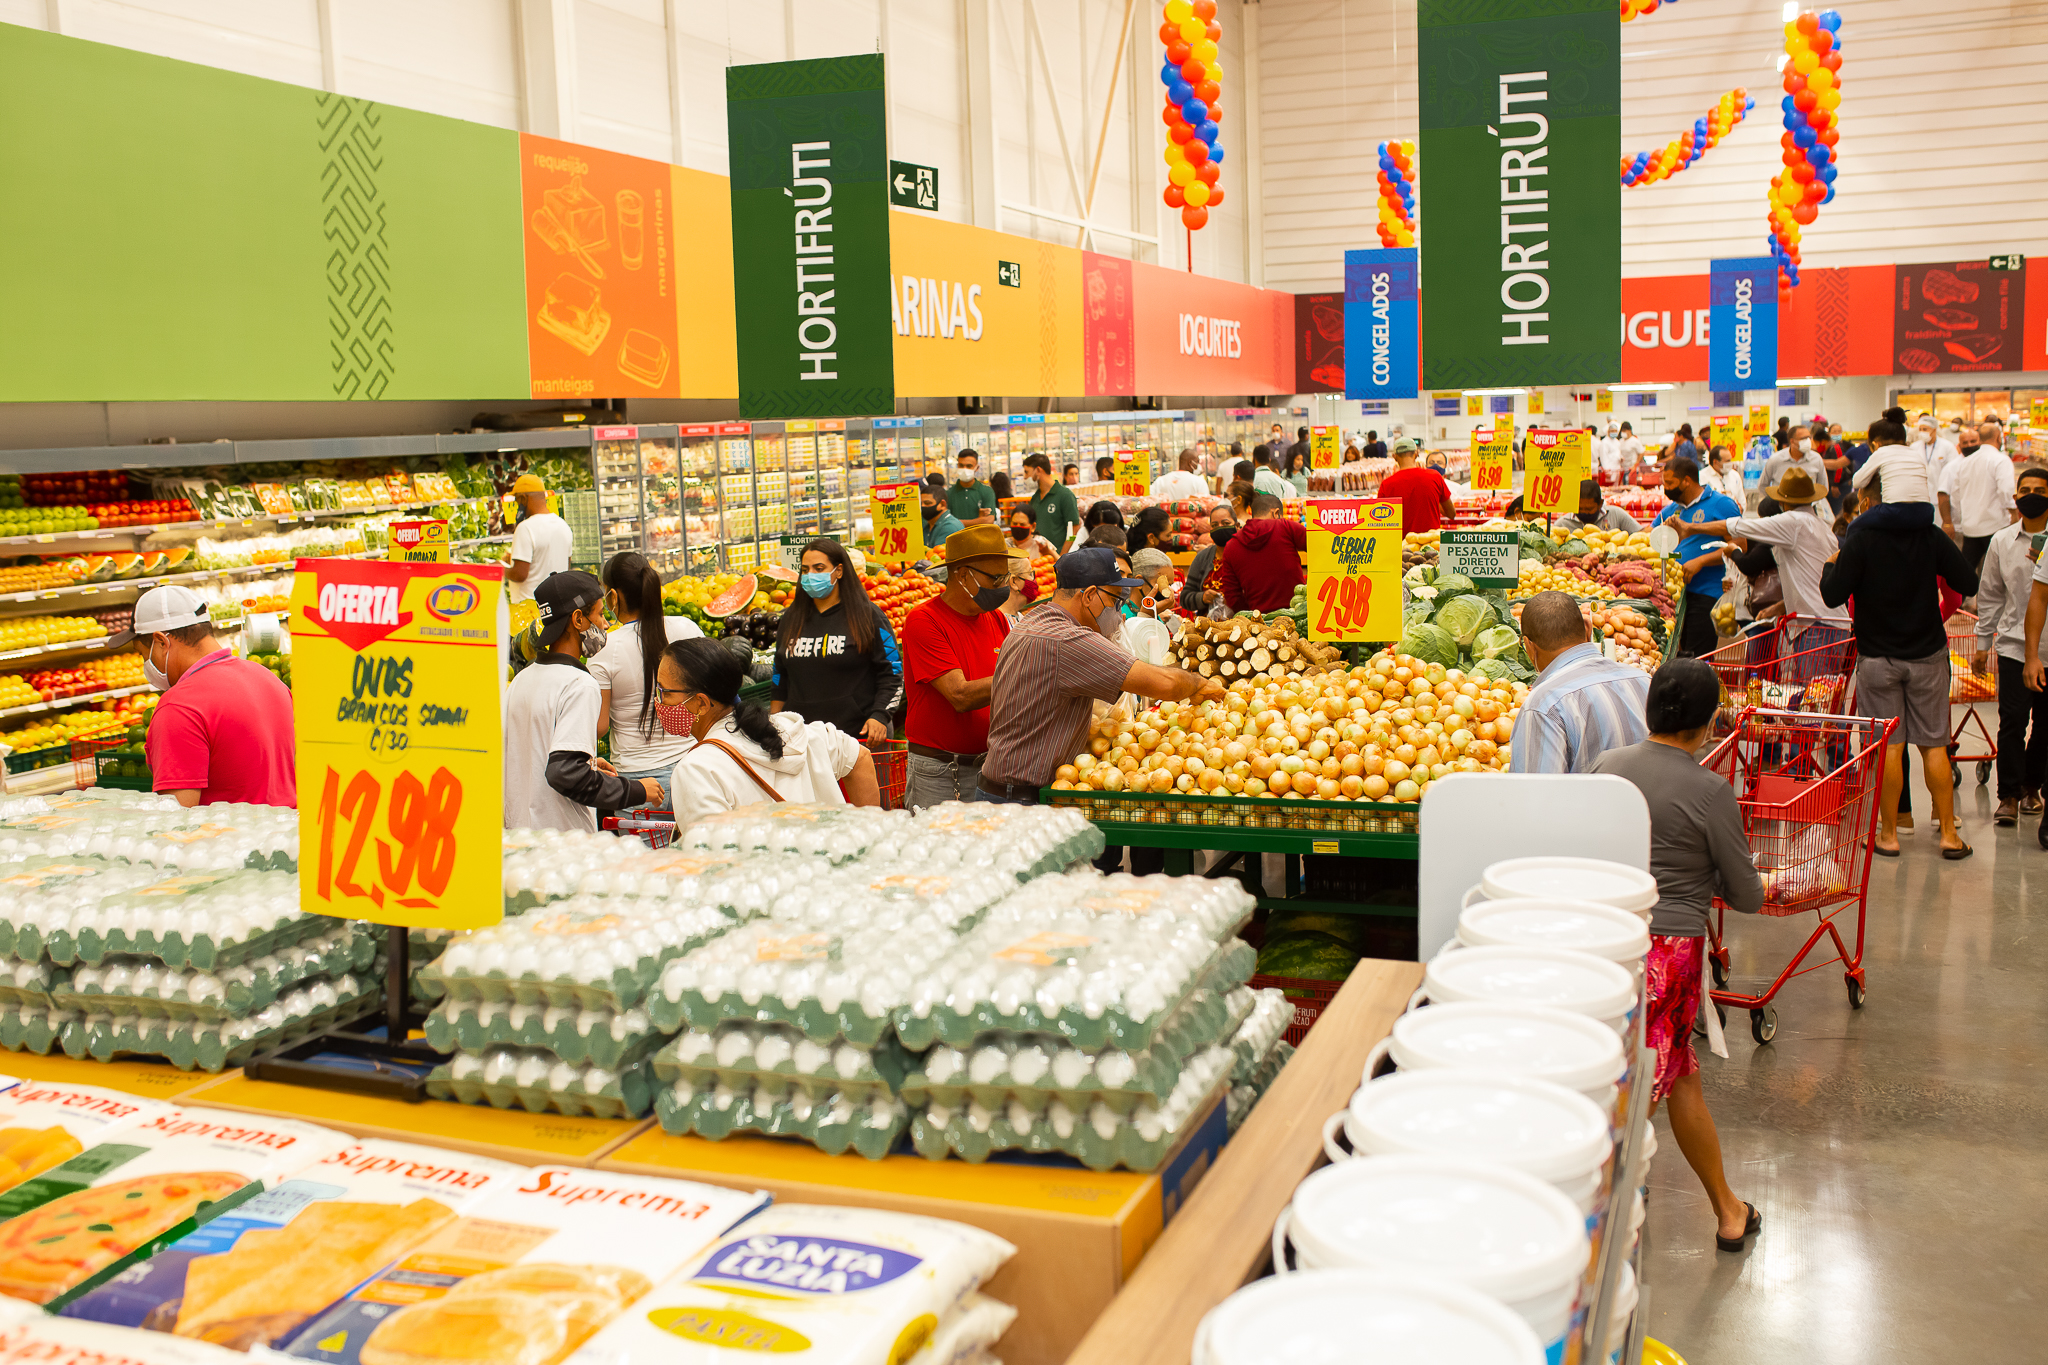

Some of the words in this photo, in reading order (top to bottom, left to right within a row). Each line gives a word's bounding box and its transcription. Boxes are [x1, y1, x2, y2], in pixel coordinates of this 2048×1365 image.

[1551, 102, 1613, 115] verduras
[533, 153, 589, 176] requeijão
[1487, 70, 1550, 346] HORTIFRÚTI
[654, 188, 667, 297] margarinas
[784, 141, 838, 381] HORTIFRÚTI
[1179, 313, 1242, 359] IOGURTES
[1371, 272, 1390, 386] CONGELADOS
[1621, 309, 1710, 349] GUE
[1734, 278, 1753, 379] CONGELADOS
[1951, 361, 2003, 372] maminha
[532, 375, 595, 396] manteigas
[1477, 433, 1494, 442] OFERTA
[1534, 434, 1557, 445] OFERTA
[1540, 450, 1565, 461] BATATA
[876, 489, 896, 499] OFERTA
[1320, 508, 1358, 525] OFERTA
[1374, 508, 1390, 517] BH
[397, 528, 420, 543] OFERTA
[1331, 535, 1377, 555] CEBOLA
[1452, 533, 1508, 543] HORTIFRUTI
[1447, 546, 1509, 557] PESAGEM
[1459, 557, 1499, 566] DIRETO
[1346, 564, 1358, 575] KG
[1452, 567, 1468, 575] NO
[1472, 567, 1505, 576] CAIXA
[318, 582, 399, 626] OFERTA
[434, 588, 472, 612] BH
[352, 653, 414, 699] OVOS
[336, 697, 408, 727] BRANCOS
[369, 727, 409, 756] C/30
[140, 1111, 298, 1150] Suprema
[321, 1145, 491, 1191] Suprema
[518, 1171, 712, 1221] Suprema
[716, 1244, 848, 1295] LUZIA
[746, 1235, 884, 1280] SANTA
